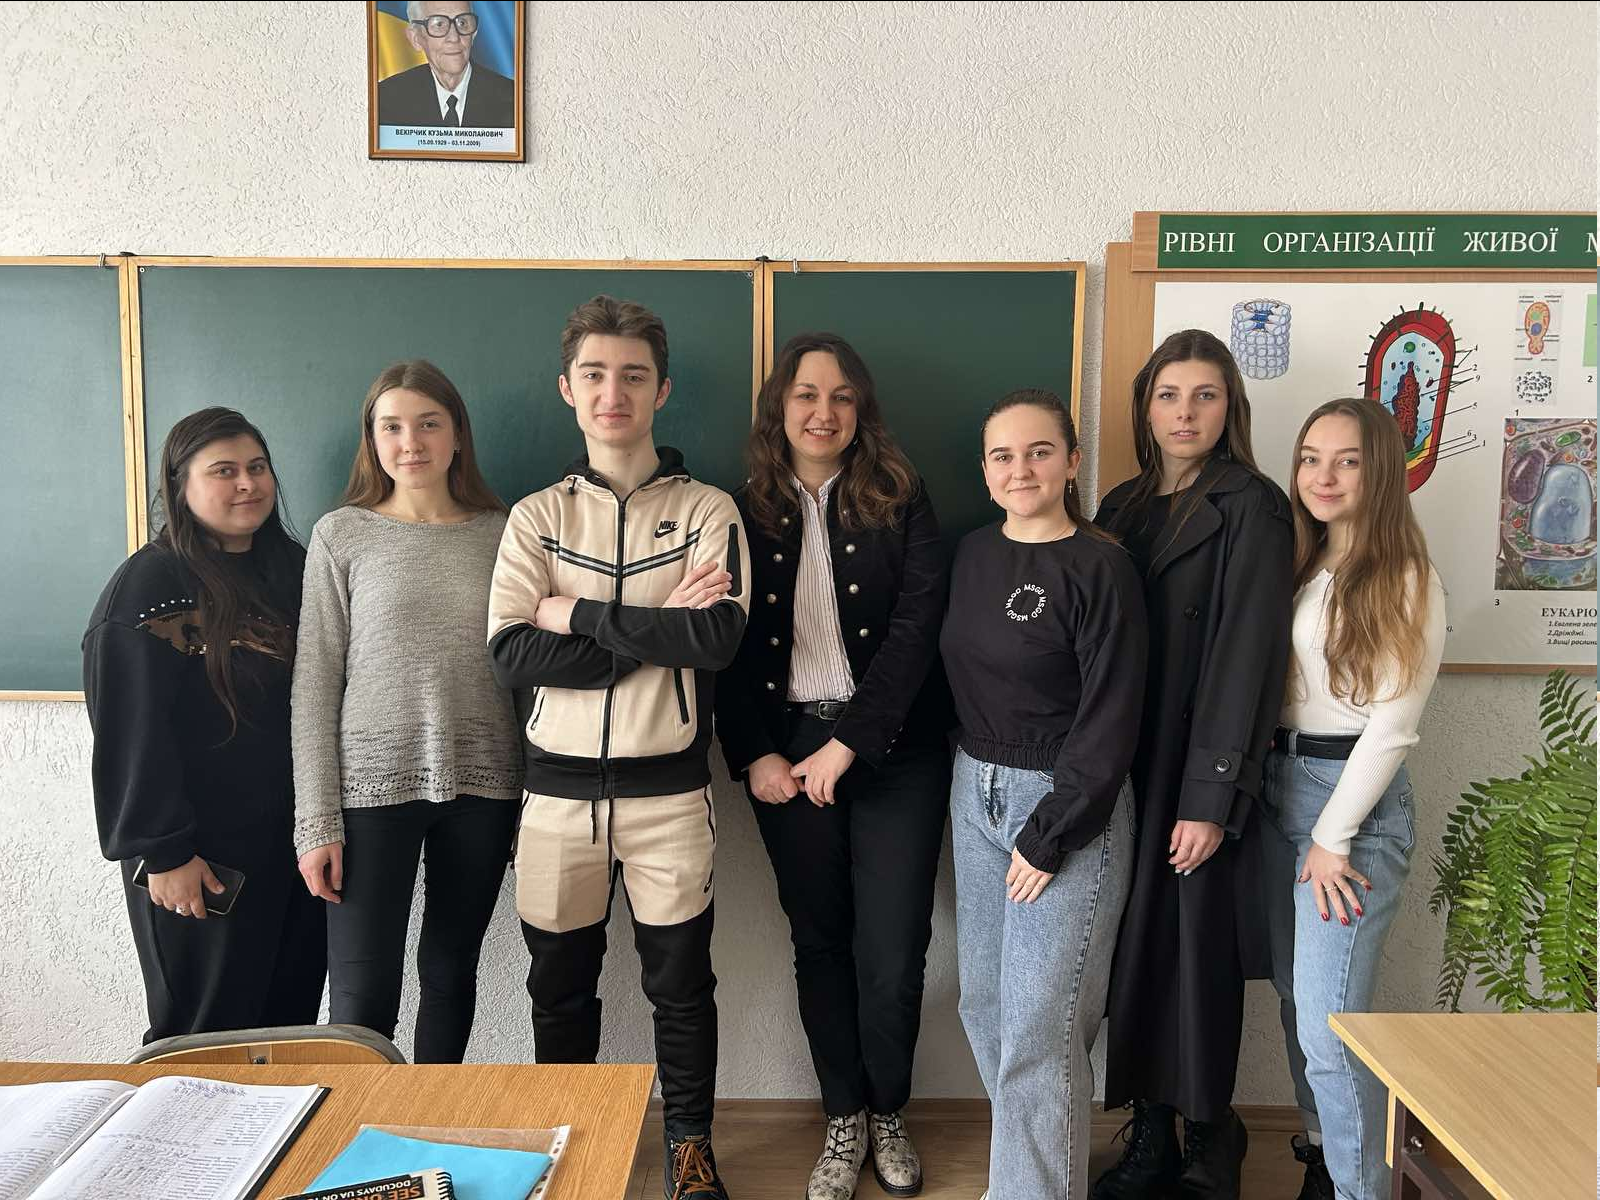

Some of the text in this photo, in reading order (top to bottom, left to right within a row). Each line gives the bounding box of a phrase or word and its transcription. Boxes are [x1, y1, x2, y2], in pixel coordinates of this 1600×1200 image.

[455, 129, 504, 137] МИКОЛАЙОВИЧ
[1164, 232, 1236, 253] РІВНІ
[1263, 227, 1436, 256] ОРГАНІЗАЦІЇ
[1463, 227, 1559, 253] ЖИВОЇ
[1587, 375, 1593, 383] 2
[659, 521, 678, 529] NIKE
[1541, 607, 1597, 617] ЕУКАРІО
[357, 1180, 411, 1196] DOCUDAYS
[340, 1191, 354, 1199] UA
[388, 1186, 420, 1200] SEE
